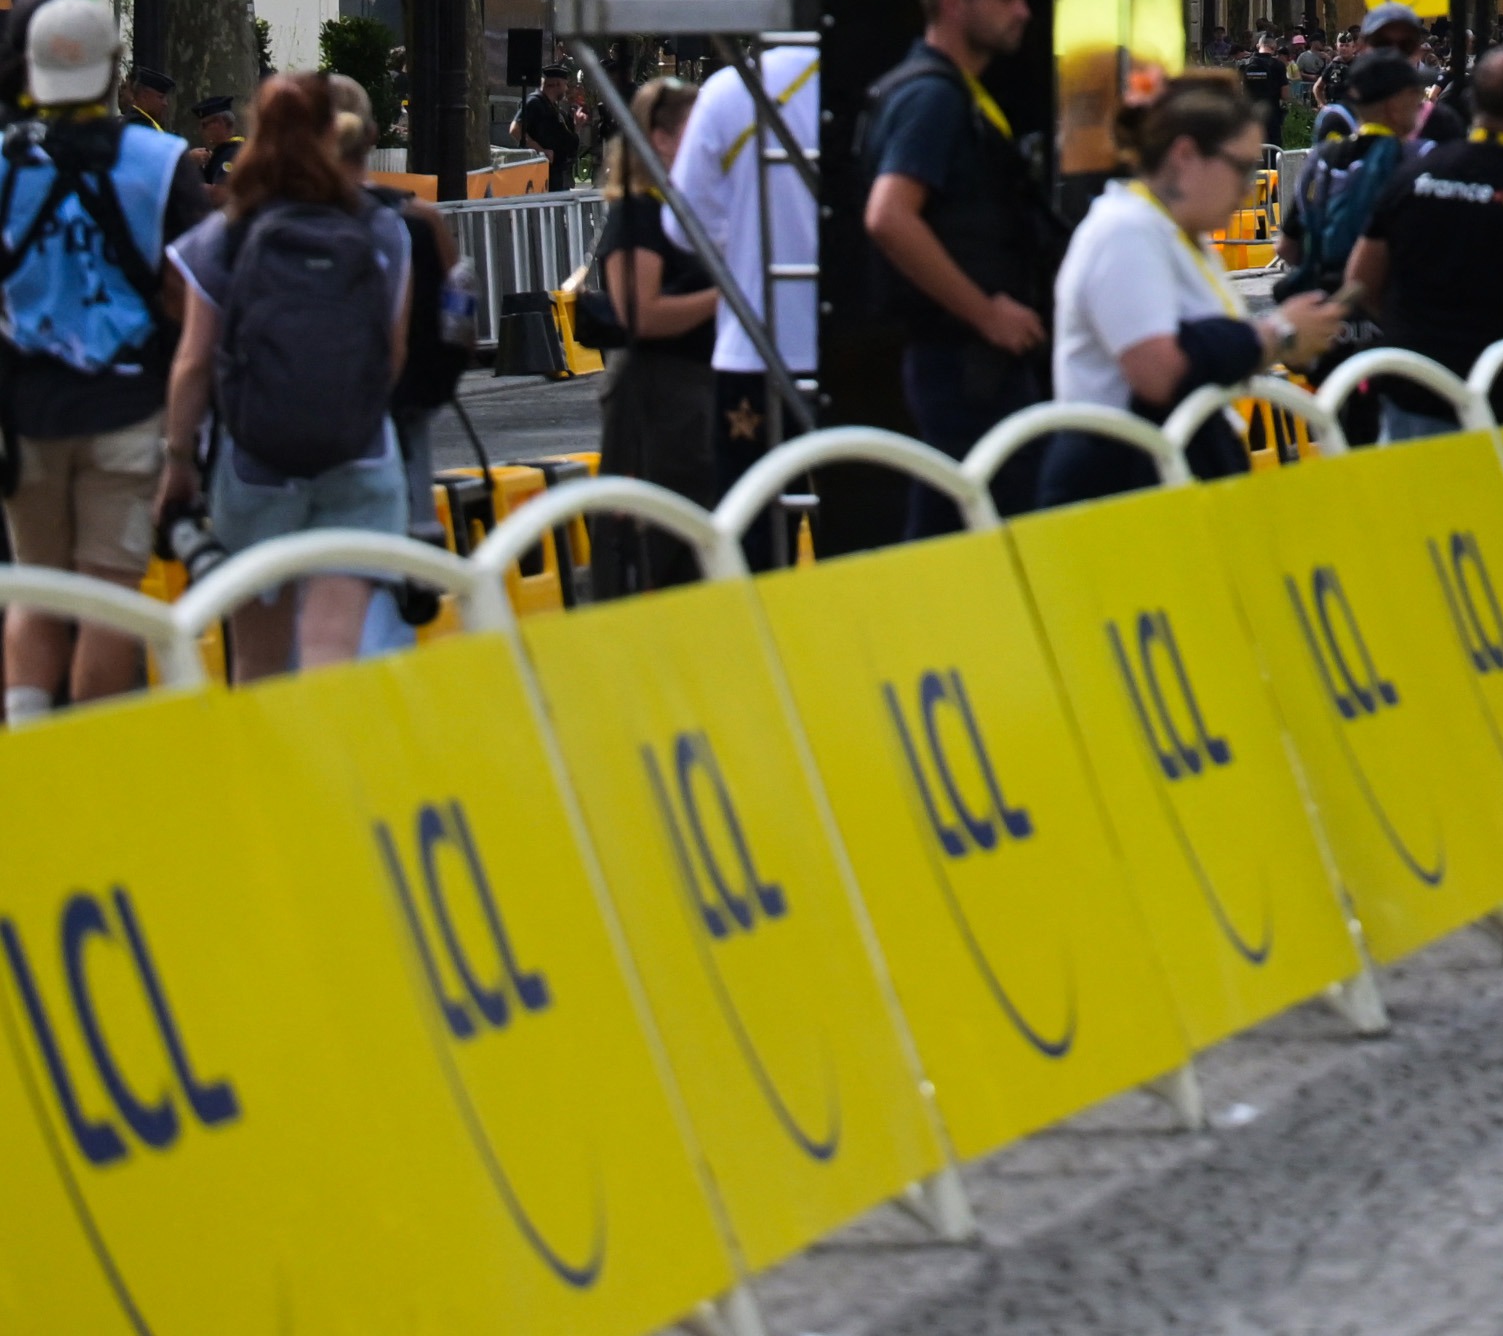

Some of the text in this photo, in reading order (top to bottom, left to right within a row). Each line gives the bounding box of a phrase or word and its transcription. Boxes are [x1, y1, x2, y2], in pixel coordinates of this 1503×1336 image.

[1413, 171, 1494, 204] france
[1107, 609, 1233, 781] LCL
[1285, 565, 1400, 720] LCL
[641, 729, 788, 941] LCL
[882, 667, 1035, 859] LCL
[373, 797, 552, 1041] LCL
[0, 883, 242, 1168] LCL
